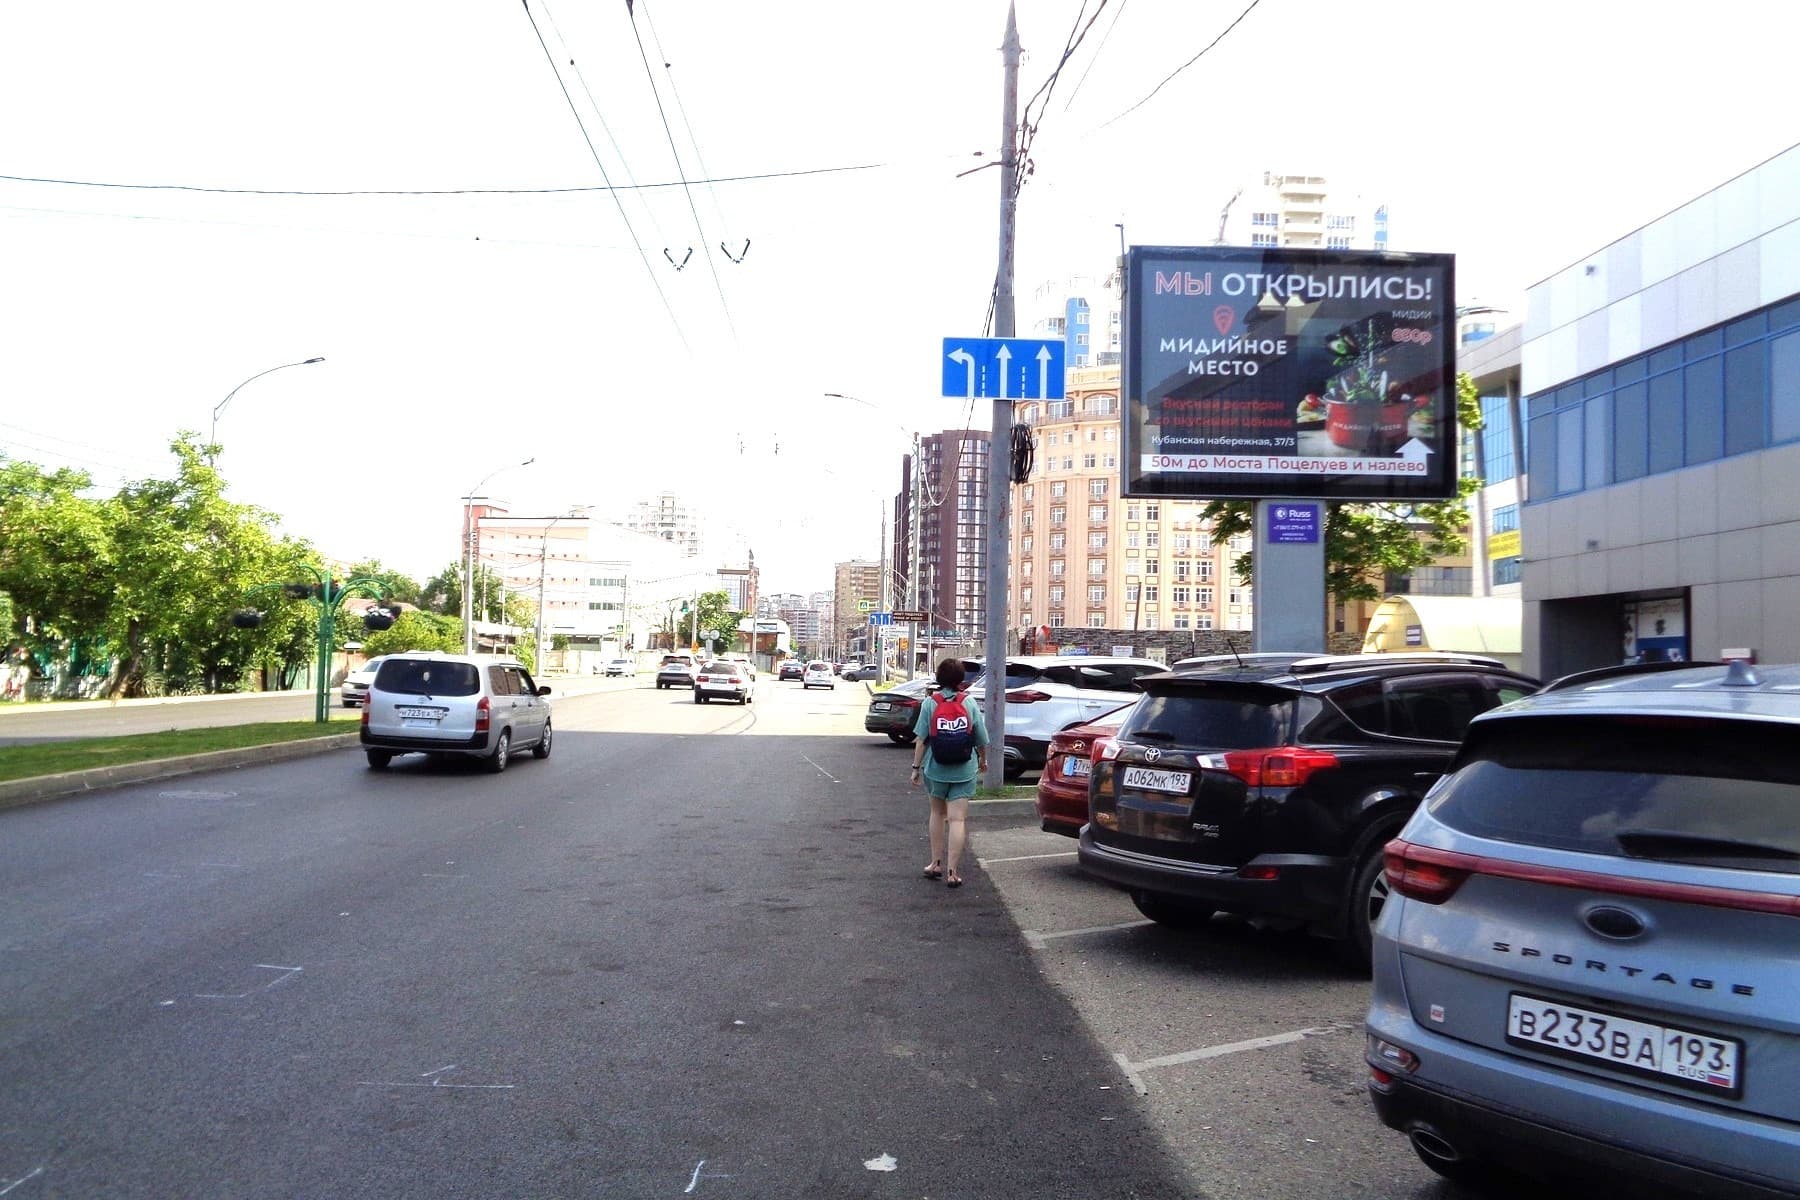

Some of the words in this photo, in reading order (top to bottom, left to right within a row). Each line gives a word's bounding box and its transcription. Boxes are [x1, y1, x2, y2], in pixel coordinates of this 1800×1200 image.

[1155, 271, 1212, 296] МЫ
[1222, 272, 1432, 301] ОТКРЫЛИСЬ!
[1159, 335, 1288, 356] МИДИЙНОЕ
[1187, 360, 1259, 377] МЕСТО
[1151, 434, 1205, 445] Кубанская
[1207, 436, 1273, 447] набережная,
[1151, 455, 1183, 468] 50м
[1187, 459, 1209, 470] до
[1213, 457, 1263, 470] Моста
[1267, 457, 1349, 473] Поцелуев
[1352, 461, 1363, 471] и
[1367, 461, 1426, 472] налево
[1288, 509, 1312, 518] Russ
[940, 718, 967, 730] FILA
[1127, 769, 1168, 788] А062МК
[1170, 773, 1187, 786] 193
[1492, 941, 1756, 997] SPORTAGE
[1518, 1008, 1657, 1067] В233ВА
[1667, 1034, 1727, 1072] 193
[1676, 1064, 1707, 1081] RUS
